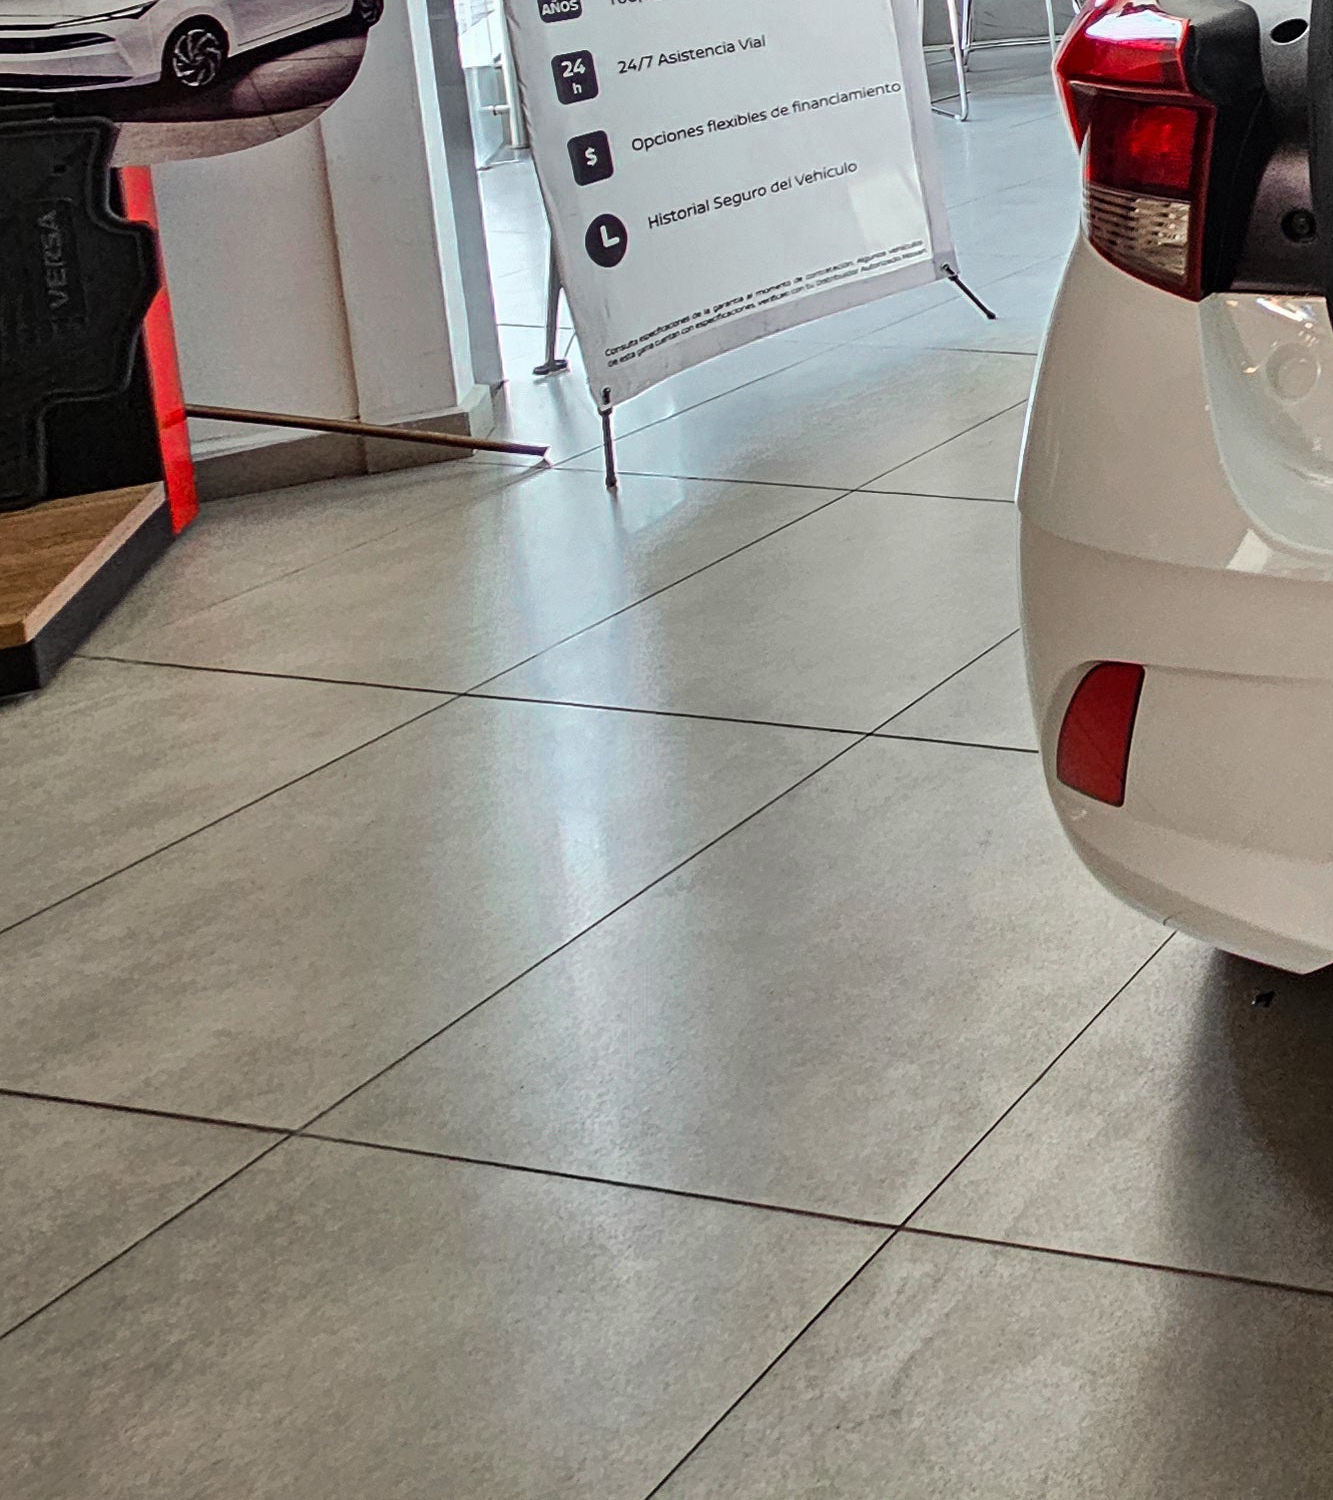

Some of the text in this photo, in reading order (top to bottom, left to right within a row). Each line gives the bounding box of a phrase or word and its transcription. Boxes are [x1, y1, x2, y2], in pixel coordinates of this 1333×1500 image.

[561, 58, 586, 78] 24
[617, 34, 766, 74] 24/7 Asistencia Vial
[572, 82, 582, 94] h
[632, 82, 902, 151] Opciones flexibles de financiamiento
[648, 162, 857, 229] Historial Seguro del Vehículo
